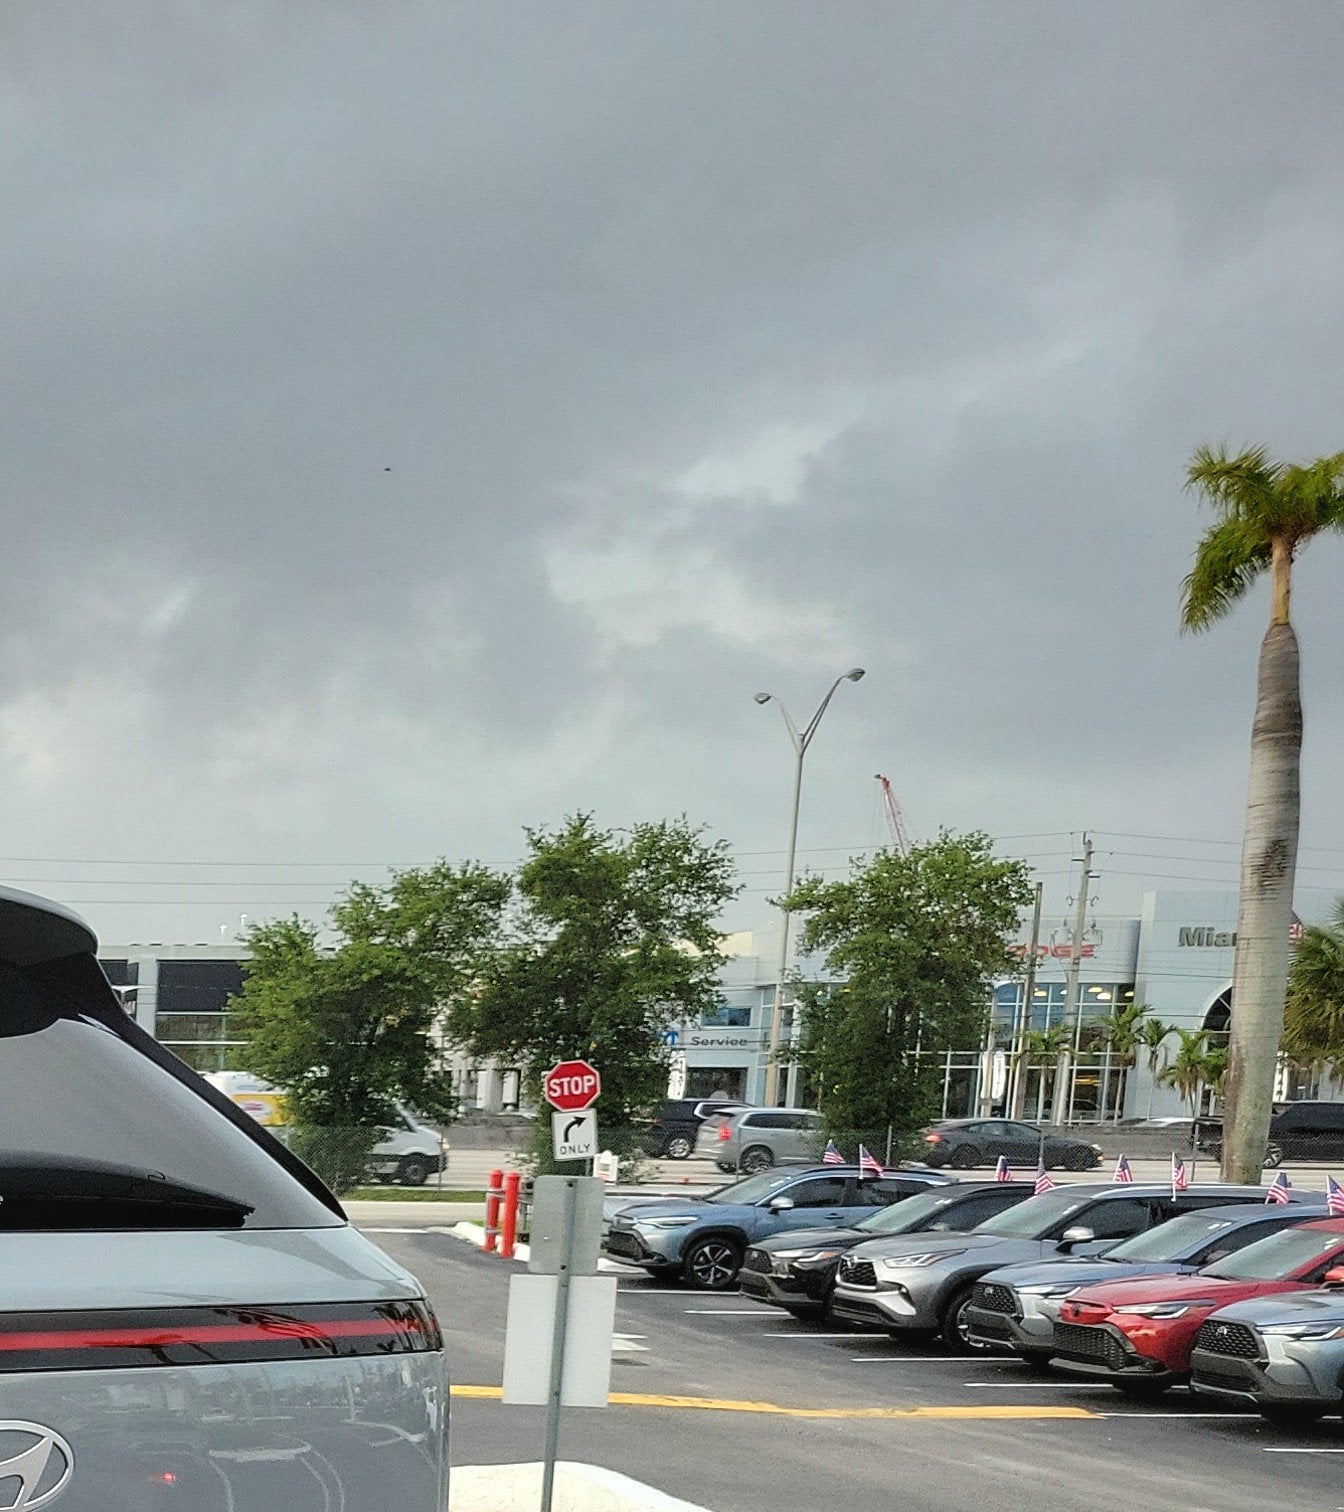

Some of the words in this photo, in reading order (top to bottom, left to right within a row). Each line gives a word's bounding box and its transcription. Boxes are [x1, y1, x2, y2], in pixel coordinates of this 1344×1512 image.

[1178, 926, 1238, 947] Mia
[692, 1036, 748, 1046] Service
[549, 1076, 596, 1098] STOP
[559, 1143, 591, 1156] ONLY
